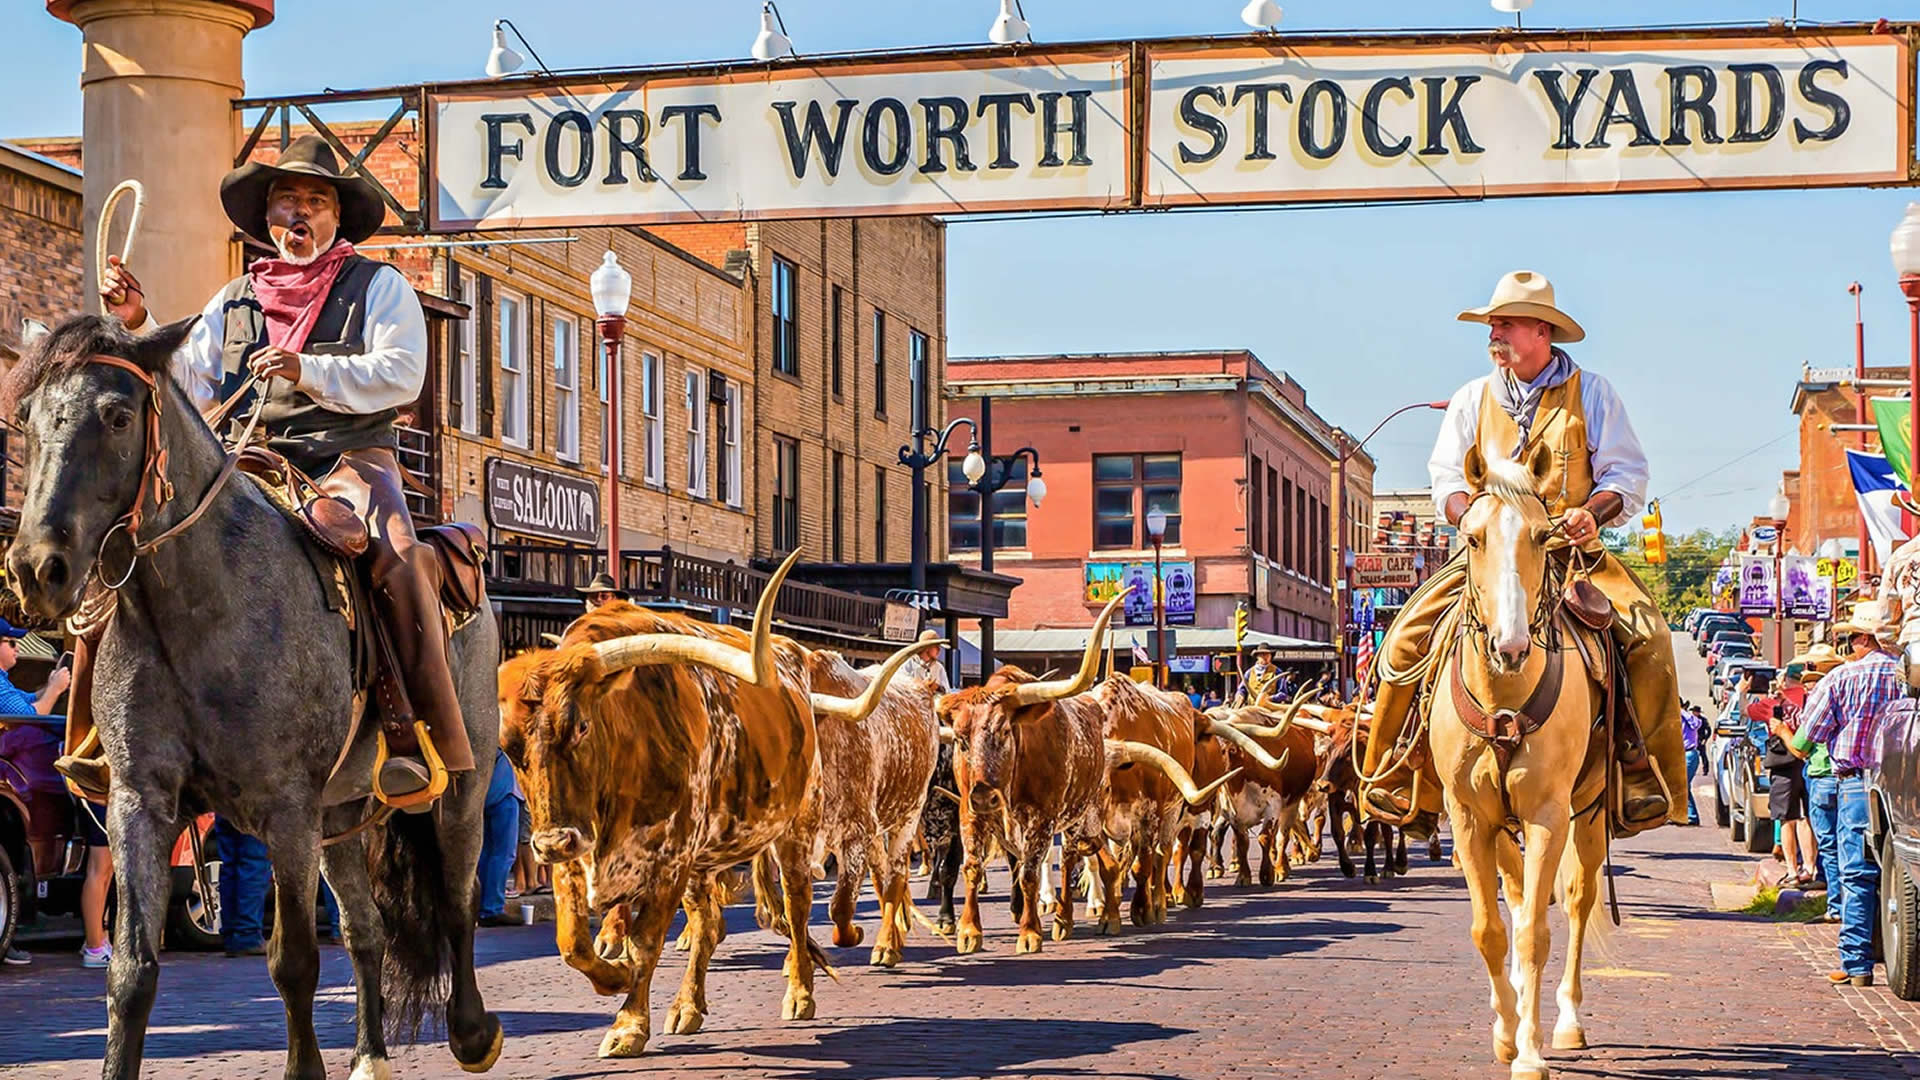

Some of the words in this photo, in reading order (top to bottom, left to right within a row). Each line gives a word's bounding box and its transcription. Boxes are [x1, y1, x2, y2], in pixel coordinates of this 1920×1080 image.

[479, 103, 722, 190] FORT
[771, 89, 1094, 180] WORTH
[1177, 75, 1486, 164] STOCK
[1533, 59, 1852, 151] YARDS
[513, 474, 578, 532] SALOON
[1355, 557, 1383, 572] STAR
[1387, 557, 1414, 572] CAFE
